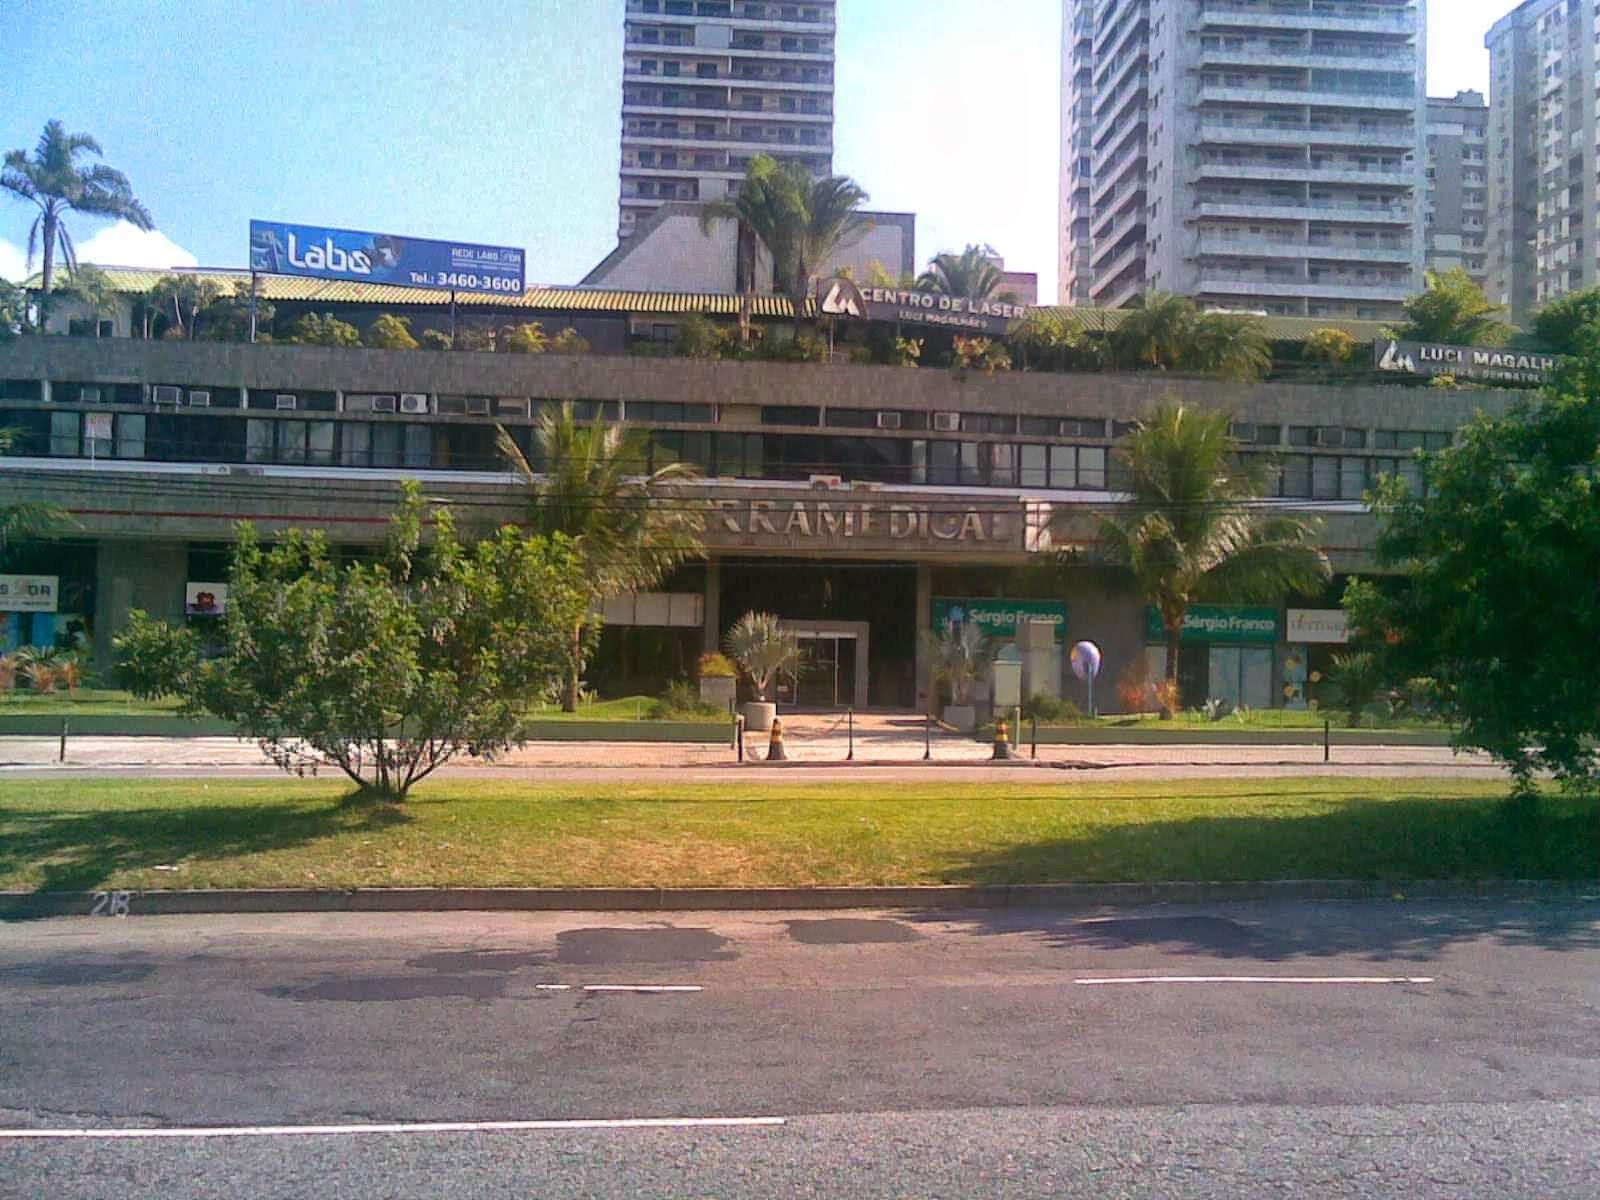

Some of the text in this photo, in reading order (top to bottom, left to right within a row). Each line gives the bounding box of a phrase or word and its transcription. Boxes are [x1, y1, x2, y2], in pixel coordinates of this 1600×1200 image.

[287, 231, 373, 274] Labs
[437, 272, 520, 291] 3460-3600
[861, 287, 1025, 318] CENTRO DE LASER
[1420, 347, 1564, 370] LUCI MAGALH
